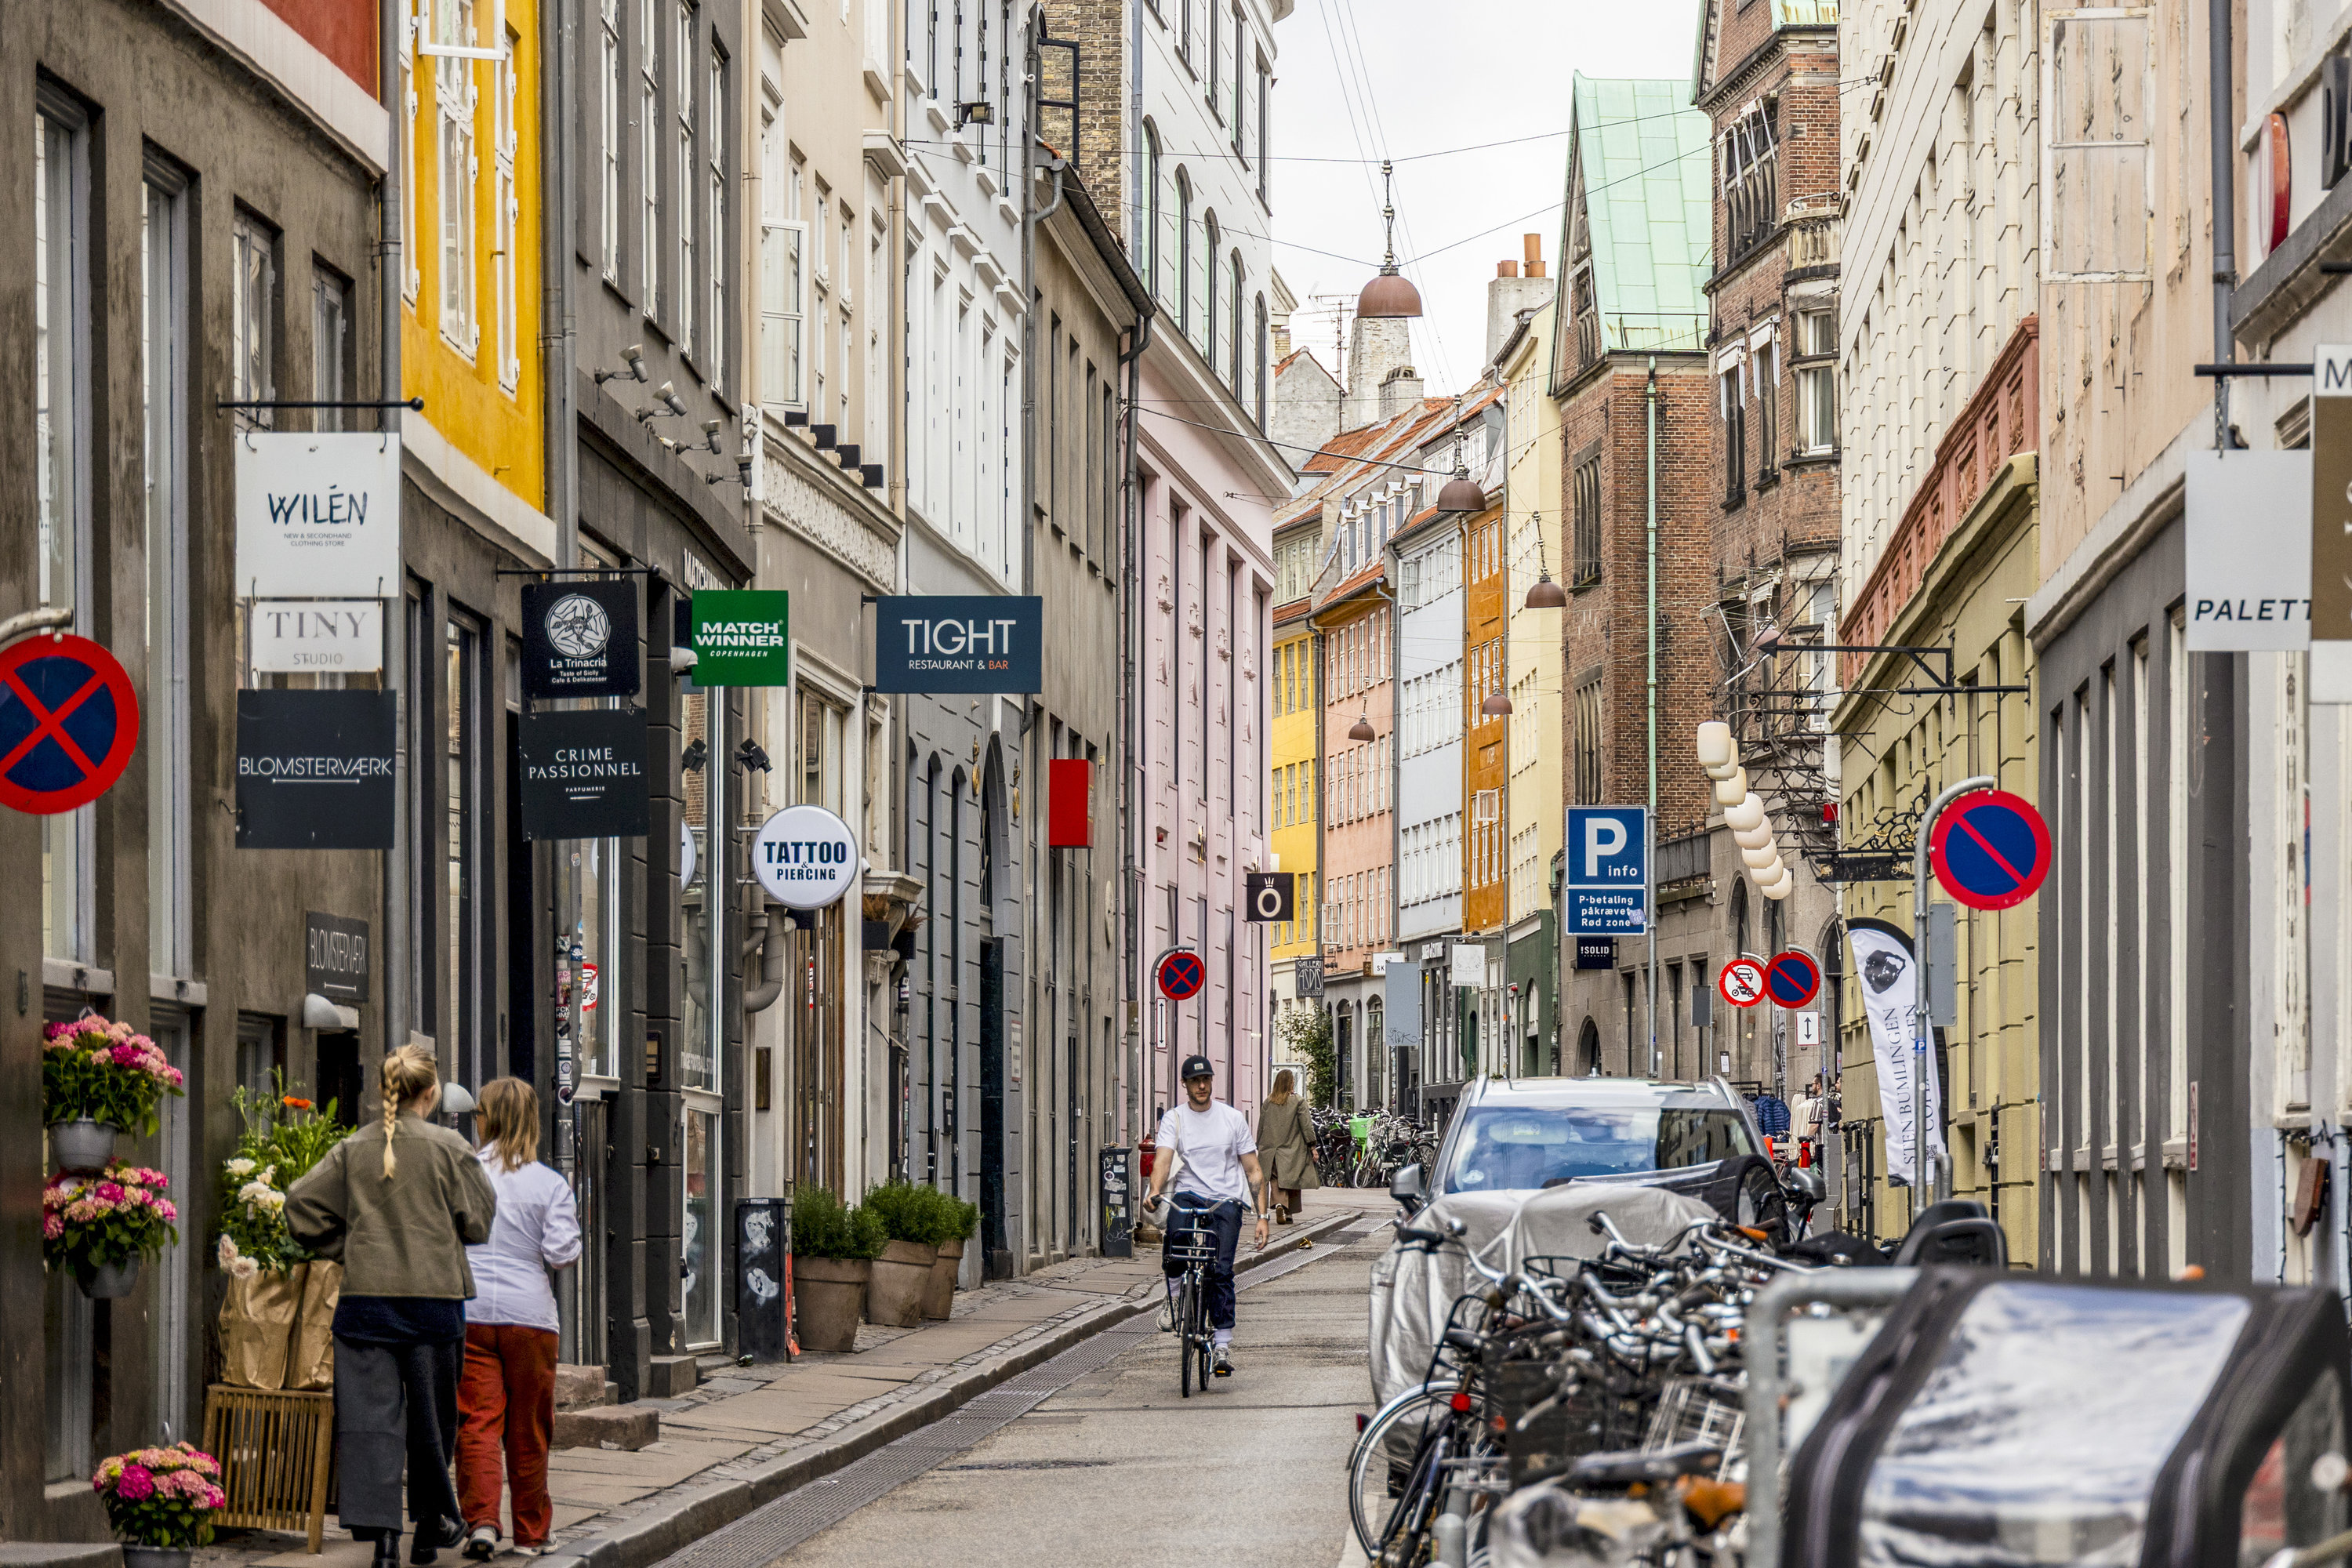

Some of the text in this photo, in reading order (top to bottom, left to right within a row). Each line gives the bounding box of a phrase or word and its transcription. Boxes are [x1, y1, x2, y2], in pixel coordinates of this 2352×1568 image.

[267, 484, 368, 525] WILÉN
[267, 612, 368, 638] TINY
[695, 634, 784, 647] WINNER
[902, 619, 1016, 655] TIGHT
[292, 653, 343, 665] STUDIO
[550, 658, 608, 668] La Trinacria
[909, 660, 1008, 670] RESTAURANT & BAR
[555, 747, 613, 762] CRIME
[239, 757, 392, 775] BLOMSTERVÆRK
[528, 762, 641, 779] PASSIONNEL
[763, 841, 847, 864] TATTOO
[1585, 818, 1628, 877] P
[777, 868, 837, 880] PIERCING
[1608, 865, 1638, 877] info
[1579, 895, 1634, 906] P-betaling
[1581, 906, 1631, 916] påkrævet
[1581, 918, 1602, 927] Rød
[310, 927, 368, 975] BLOMSTERVÆRK
[1883, 1007, 1916, 1165] STEN BUMLINGEN
